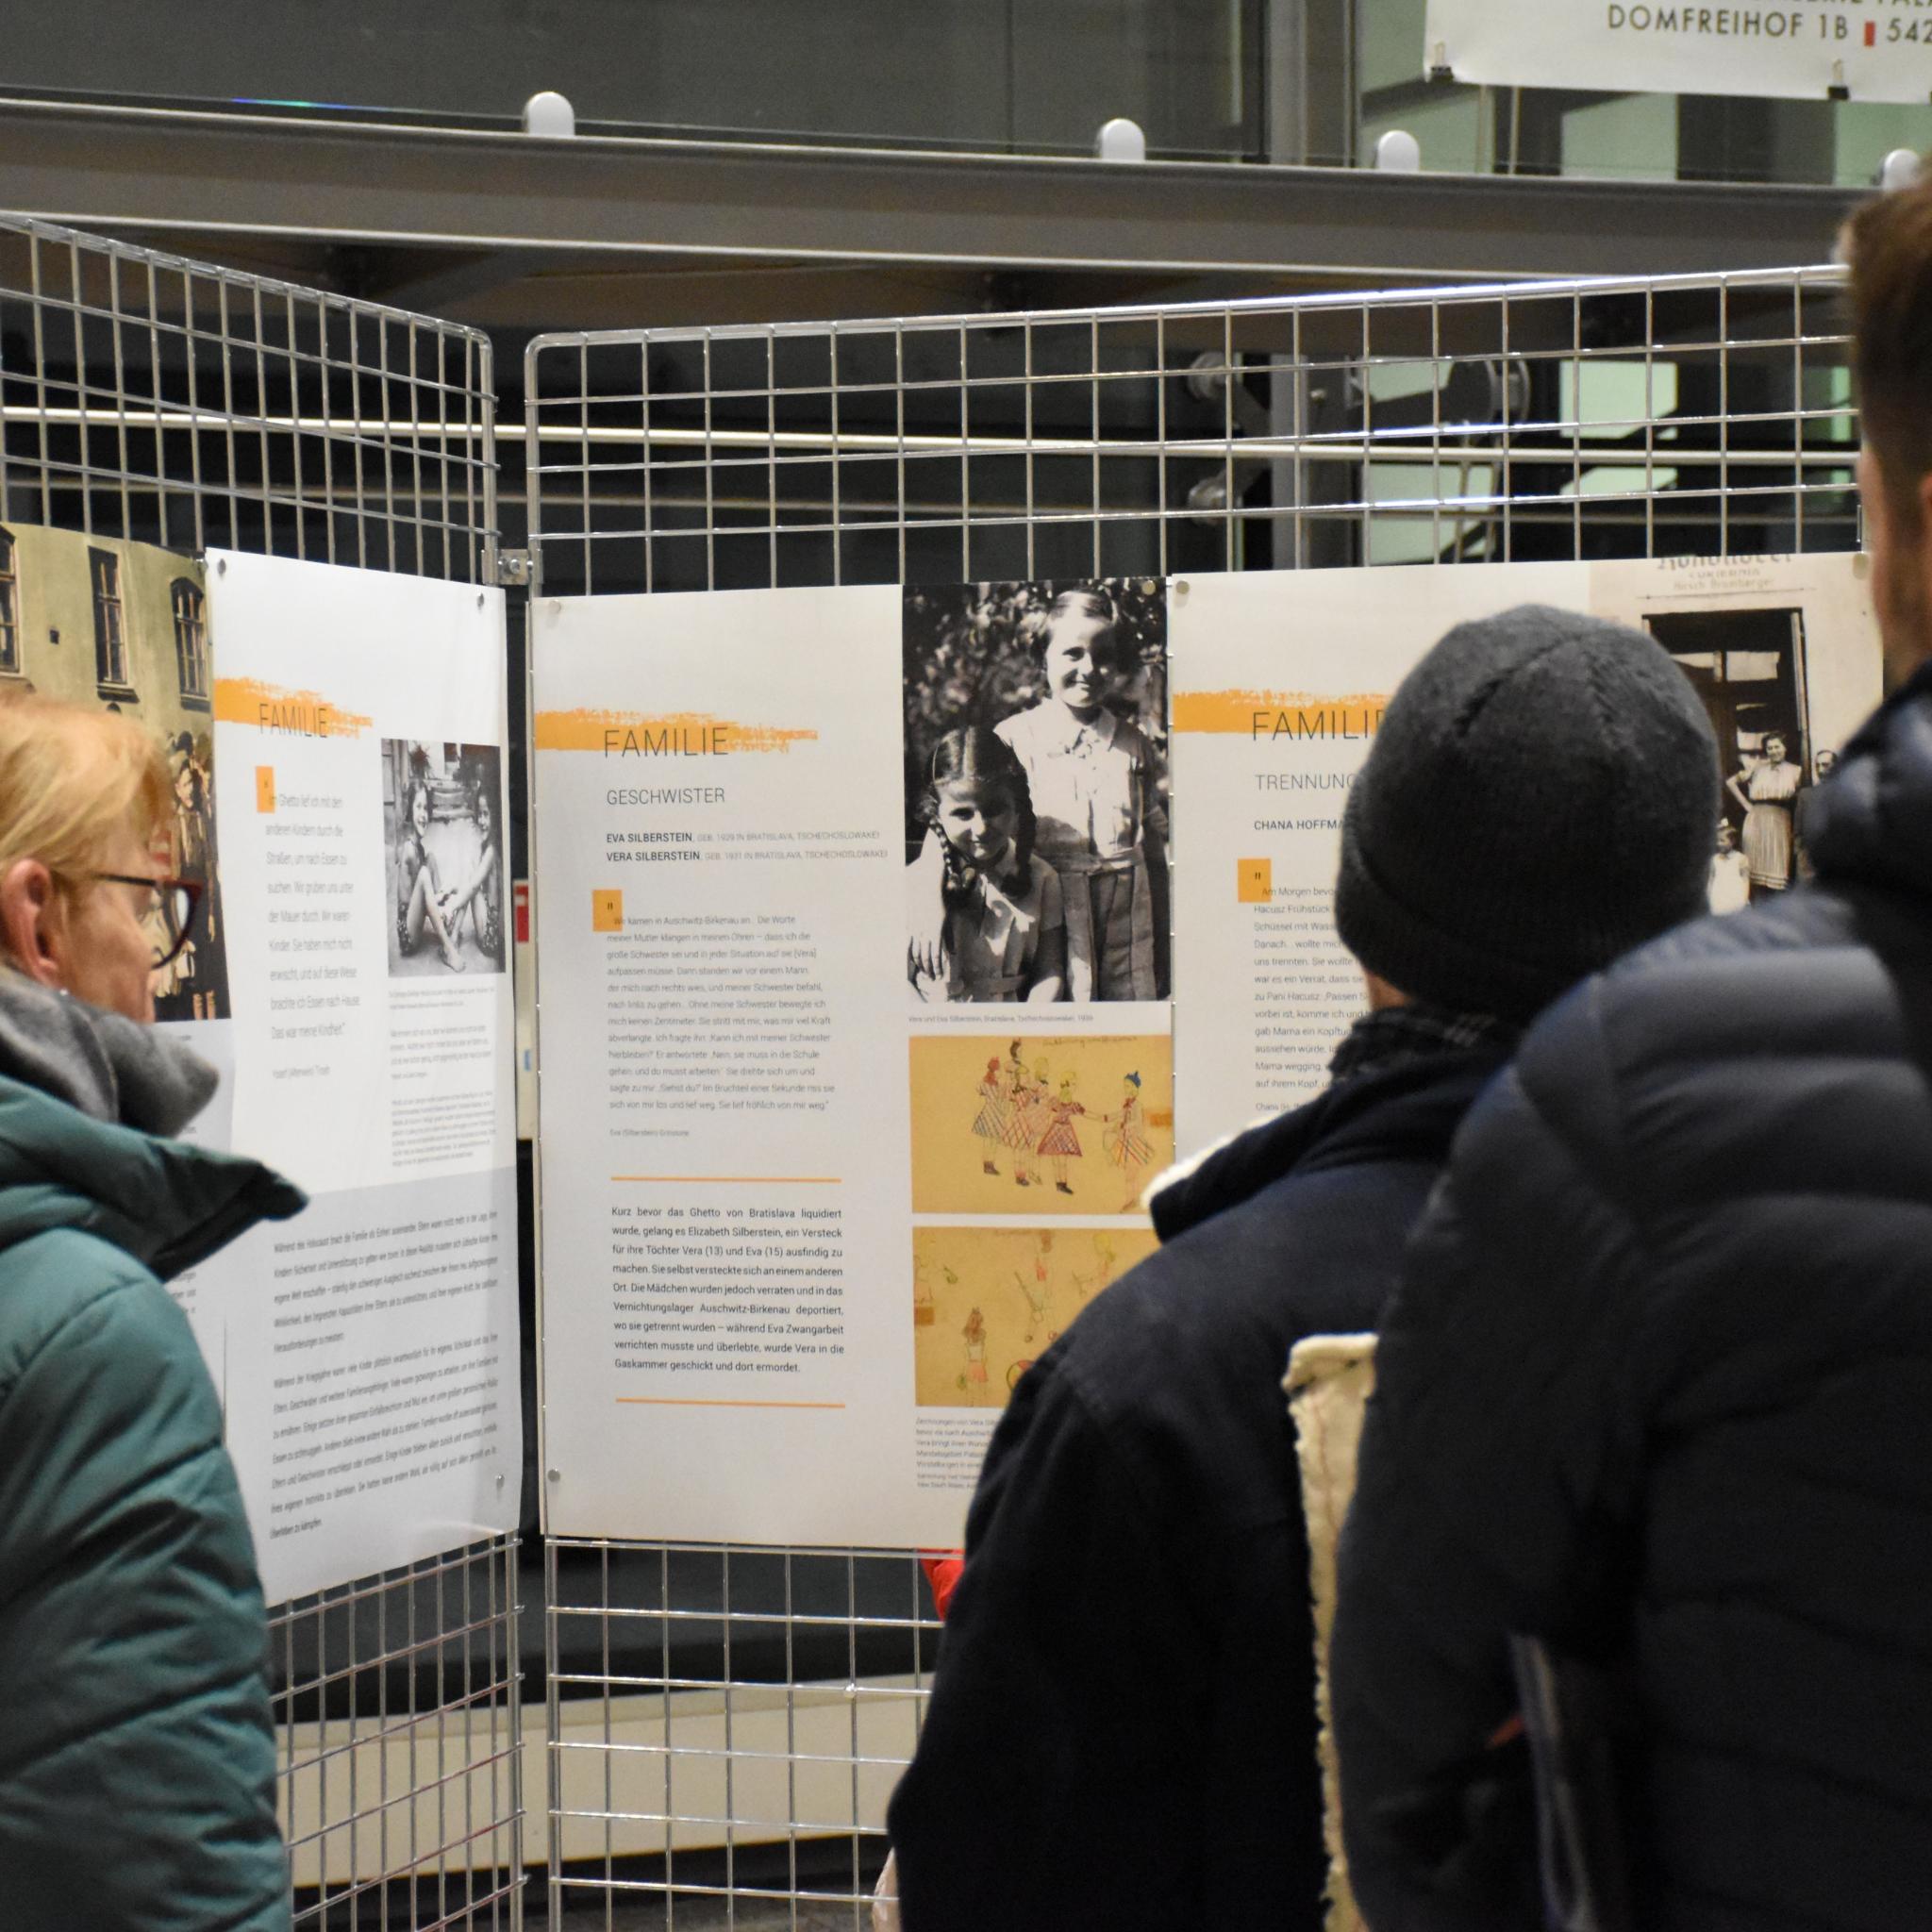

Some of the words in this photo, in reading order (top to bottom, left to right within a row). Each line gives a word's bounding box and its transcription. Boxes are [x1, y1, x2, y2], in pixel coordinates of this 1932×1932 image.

[1607, 4, 1803, 37] DOMFREIHOF
[1820, 14, 1848, 40] 1B
[259, 703, 328, 738] FAMILIE
[604, 726, 729, 758] FAMILIE
[606, 787, 725, 806] GESCHWISTER
[1254, 821, 1293, 830] CHANA
[607, 834, 625, 842] EVA
[607, 852, 632, 861] VERA
[612, 1208, 631, 1216] Kurz
[638, 1208, 661, 1216] bevor
[668, 1208, 684, 1216] das
[690, 1208, 720, 1217] Ghetto
[726, 1209, 743, 1218] von
[749, 1208, 795, 1218] Bratislava
[802, 1208, 841, 1220] liquidiert
[612, 1226, 641, 1235] wurde,
[643, 1226, 673, 1238] gelang
[689, 1226, 729, 1236] Elizabeth
[732, 1227, 783, 1238] Silberstein,
[786, 1228, 799, 1237] ein
[802, 1228, 841, 1238] Versteck
[612, 1244, 625, 1254] für
[627, 1245, 643, 1255] ihre
[646, 1245, 679, 1255] Töchter
[682, 1246, 702, 1255] Vera
[706, 1246, 723, 1257] (13)
[725, 1246, 742, 1256] und
[746, 1246, 762, 1256] Eva
[765, 1246, 783, 1257] (15)
[786, 1247, 828, 1258] ausfindig
[831, 1249, 842, 1257] zu
[652, 1264, 666, 1274] Sie
[667, 1264, 693, 1274] selbst
[695, 1265, 741, 1275] versteckte
[743, 1266, 761, 1275] sich
[776, 1267, 804, 1275] einem
[806, 1268, 842, 1276] anderen
[631, 1283, 645, 1292] Die
[647, 1283, 688, 1293] Mädchen
[690, 1285, 723, 1293] wurden
[724, 1285, 755, 1296] jedoch
[758, 1287, 794, 1295] verraten
[797, 1286, 813, 1295] und
[816, 1287, 824, 1295] in
[826, 1286, 842, 1296] das
[613, 1302, 693, 1314] Vernichtungslager
[700, 1304, 790, 1314] Auschwitz-Birkenau
[796, 1306, 843, 1316] deportiert,
[643, 1323, 680, 1333] getrennt
[682, 1323, 715, 1332] wurden
[726, 1324, 765, 1333] während
[768, 1324, 784, 1333] Eva
[786, 1324, 843, 1336] Zwangarbeit
[615, 1341, 658, 1350] verrichten
[661, 1342, 694, 1351] musste
[697, 1341, 713, 1351] und
[764, 1343, 792, 1353] wurde
[795, 1343, 815, 1353] Vera
[830, 1344, 844, 1354] die
[615, 1358, 667, 1369] Gaskammer
[670, 1360, 713, 1372] geschickt
[716, 1361, 733, 1371] und
[735, 1361, 753, 1371] dort
